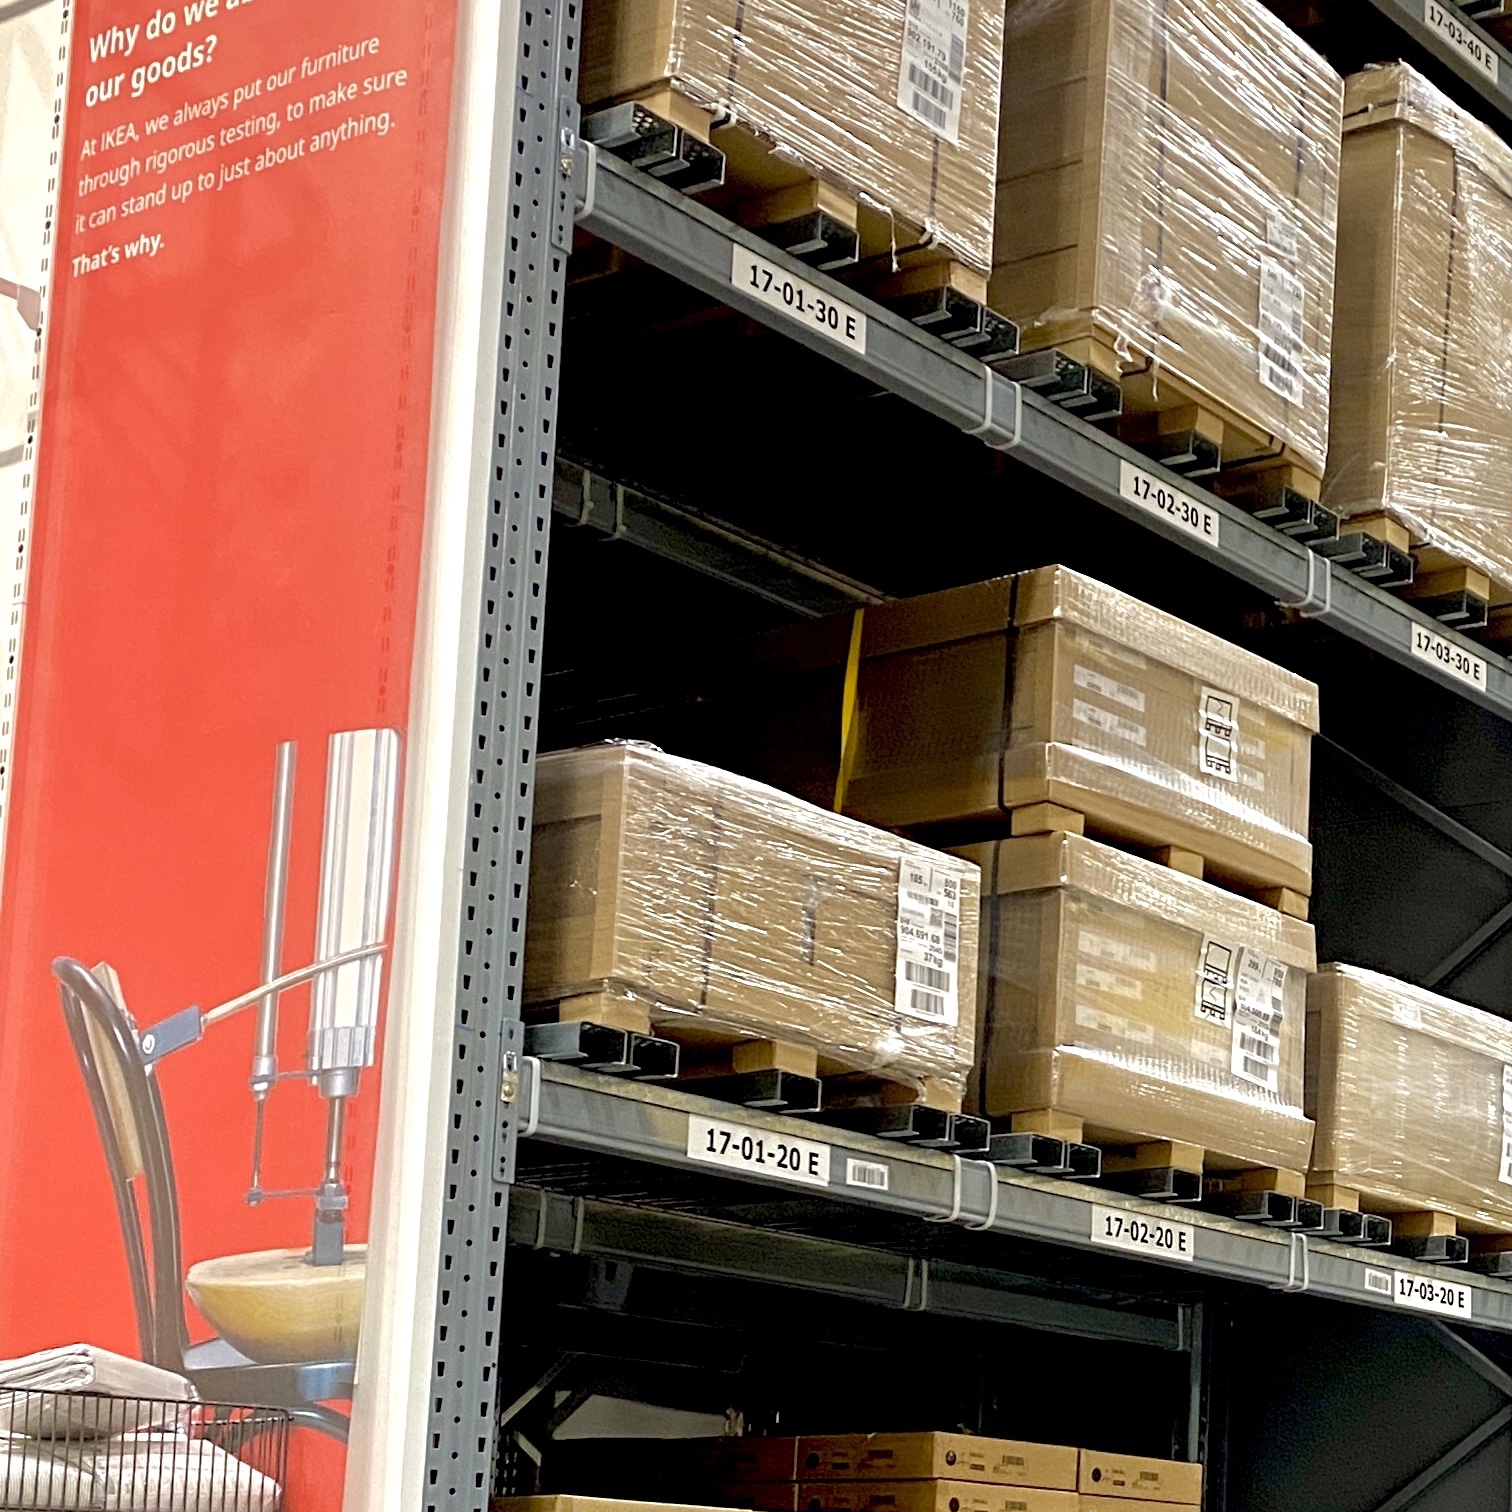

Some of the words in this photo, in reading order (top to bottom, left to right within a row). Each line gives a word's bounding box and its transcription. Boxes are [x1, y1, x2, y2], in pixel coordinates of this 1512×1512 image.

[89, 24, 140, 63] Why
[146, 9, 176, 40] do
[184, 0, 218, 26] we
[1430, 6, 1482, 60] 17-03-40
[1485, 53, 1492, 71] E
[80, 139, 97, 161] At
[101, 122, 139, 152] IKEA,
[145, 114, 169, 135] we
[173, 92, 229, 126] always
[233, 78, 262, 110] put
[266, 66, 297, 91] our
[301, 37, 380, 79] furniture
[86, 72, 125, 107] our
[131, 35, 217, 98] goods?
[78, 157, 141, 197] through
[145, 134, 215, 174] rigorous
[219, 112, 281, 147] testing,
[286, 102, 304, 122] to
[309, 82, 358, 114] make
[362, 69, 408, 95] sure
[75, 213, 86, 235] it
[88, 205, 117, 229] can
[120, 183, 167, 217] stand
[171, 179, 193, 203] up
[197, 171, 215, 192] to
[216, 156, 251, 191] just
[254, 138, 305, 171] about
[309, 112, 396, 152] anything.
[72, 245, 120, 278] That's
[124, 233, 165, 259] why.
[750, 265, 838, 330] 17-01-30
[846, 315, 856, 340] E
[1133, 476, 1198, 527] 17-02-30
[1204, 514, 1211, 535] E
[1417, 632, 1470, 674] 17-03-30
[1473, 663, 1480, 680] E
[706, 1128, 801, 1171] 17-01-20
[809, 1152, 819, 1176] E
[1105, 1215, 1173, 1248] 17-02-20
[1178, 1231, 1186, 1252] E
[1399, 1278, 1454, 1306] 17-03-20
[1458, 1291, 1465, 1309] E
